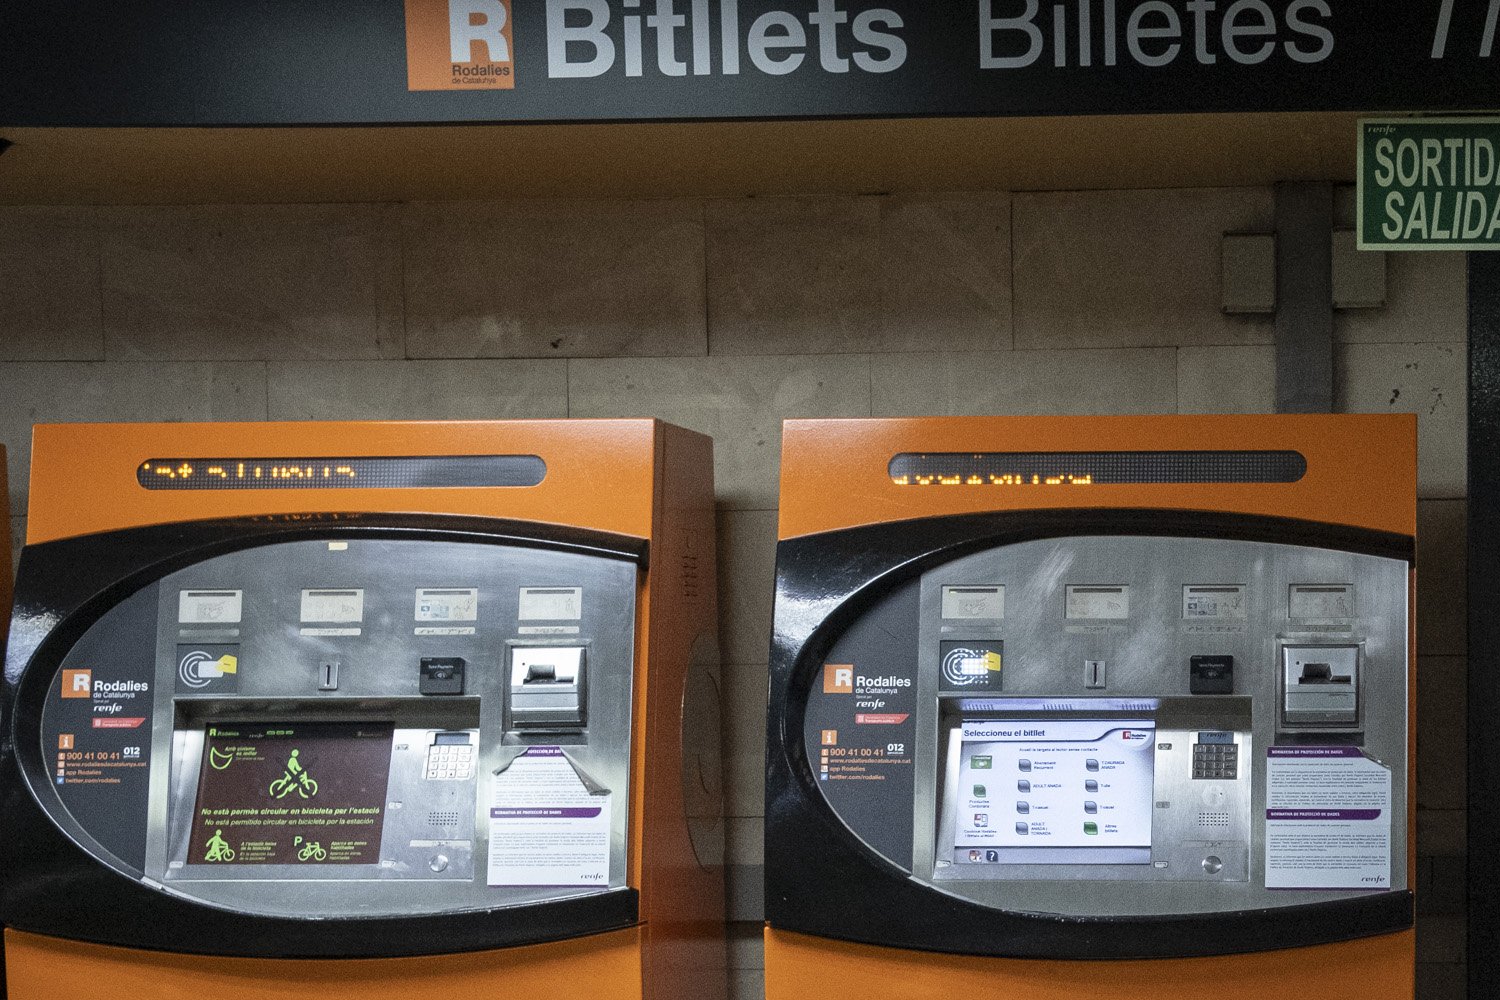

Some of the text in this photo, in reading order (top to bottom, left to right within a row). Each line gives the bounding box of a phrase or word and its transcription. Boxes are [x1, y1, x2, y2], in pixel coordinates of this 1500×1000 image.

[547, 0, 907, 78] Bitllets
[980, 0, 1334, 70] Billetes
[452, 64, 510, 76] Rodalies
[462, 77, 496, 85] Catalunya
[1367, 126, 1397, 135] renfe
[94, 680, 148, 691] Rodalies
[856, 676, 911, 687] Rodalies
[103, 691, 135, 699] Catalunya
[866, 687, 898, 695] Catalunya
[856, 698, 885, 710] renfe
[93, 703, 122, 714] renfe
[123, 747, 140, 755] 012
[887, 743, 904, 751] 012
[66, 752, 120, 760] 900 41 00 41
[830, 748, 884, 756] 900 41 00 41
[230, 808, 258, 816] permès
[230, 818, 262, 826] permitido
[294, 836, 303, 846] P
